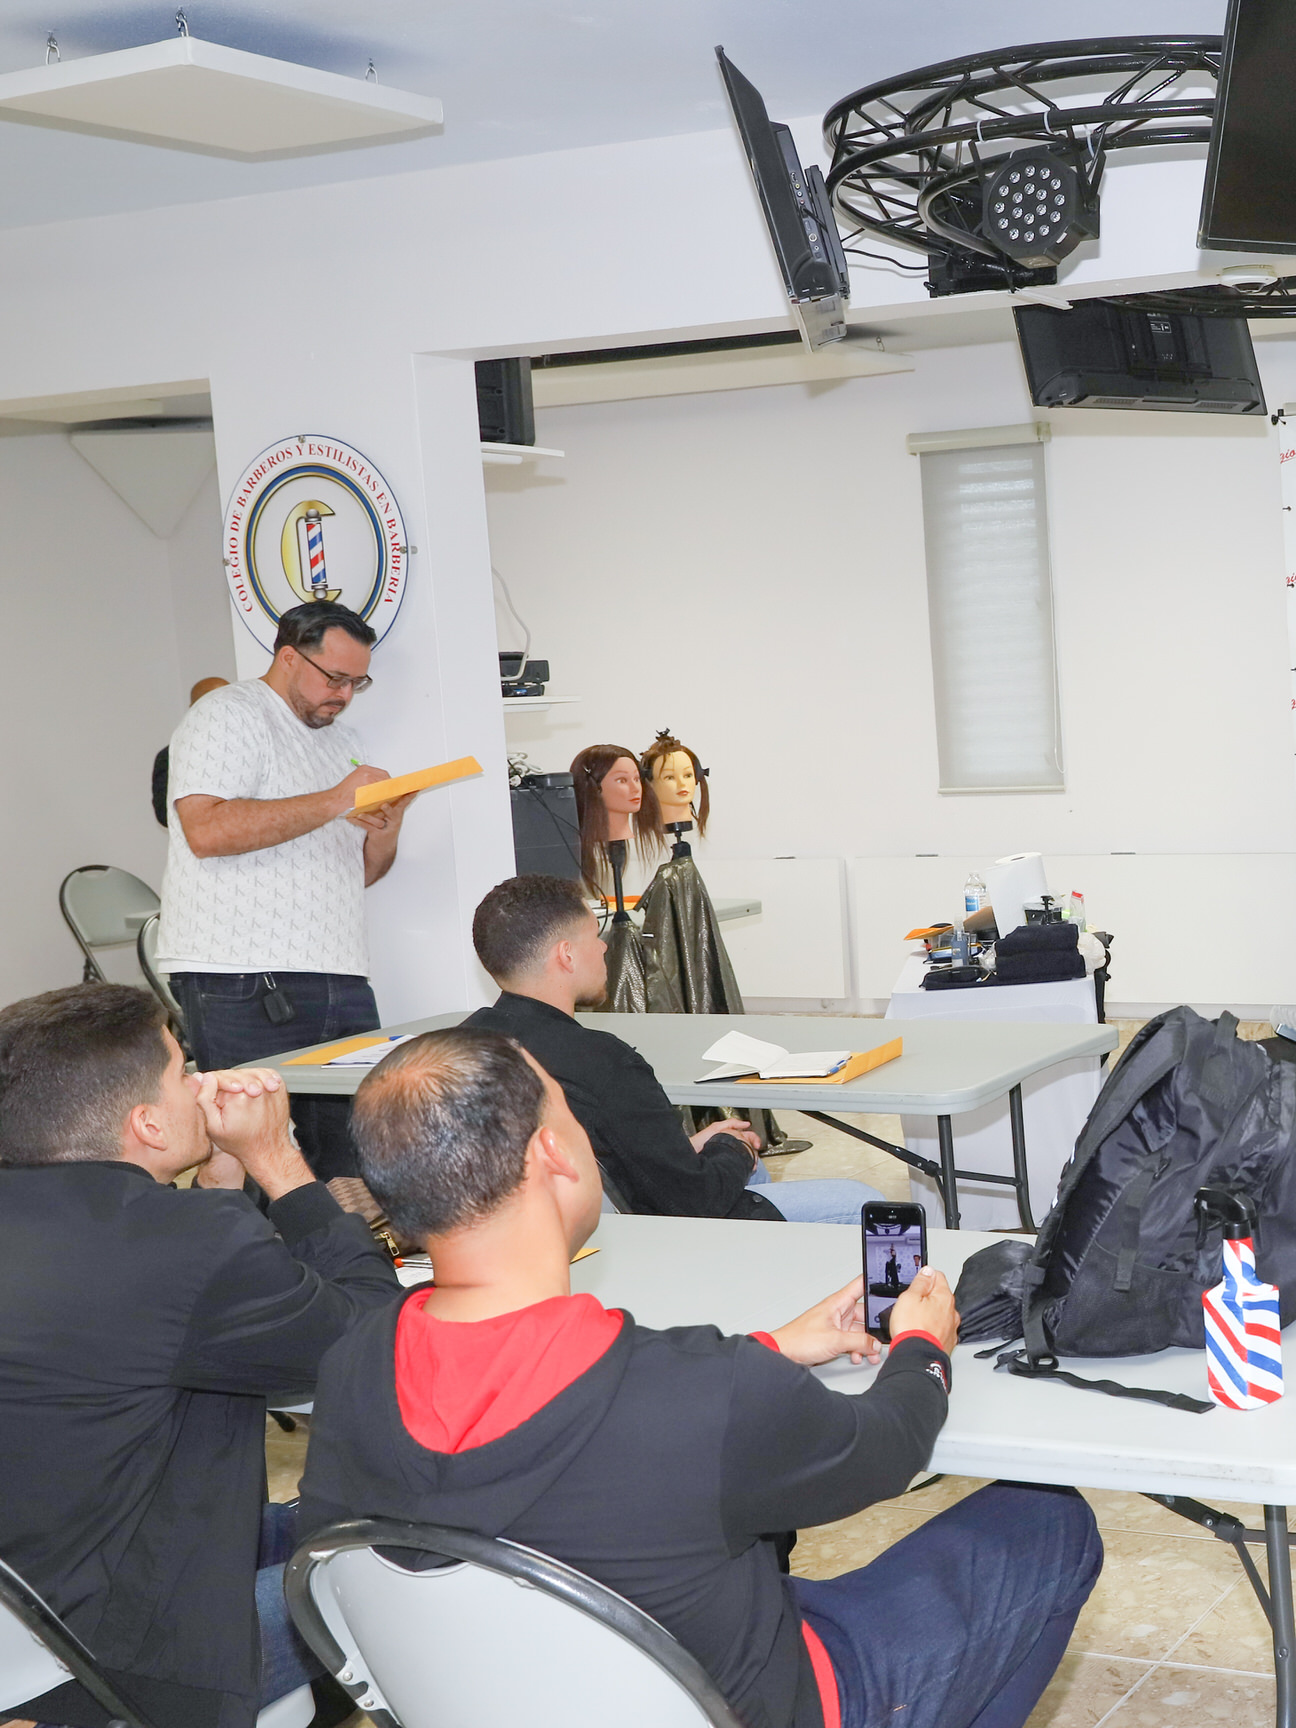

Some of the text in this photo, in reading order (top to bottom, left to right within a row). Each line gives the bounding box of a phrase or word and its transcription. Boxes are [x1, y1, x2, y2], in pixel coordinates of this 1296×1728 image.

[229, 443, 402, 612] COLEGIO DE BARBEROS Y ESTILISTAS EN BARBERIA
